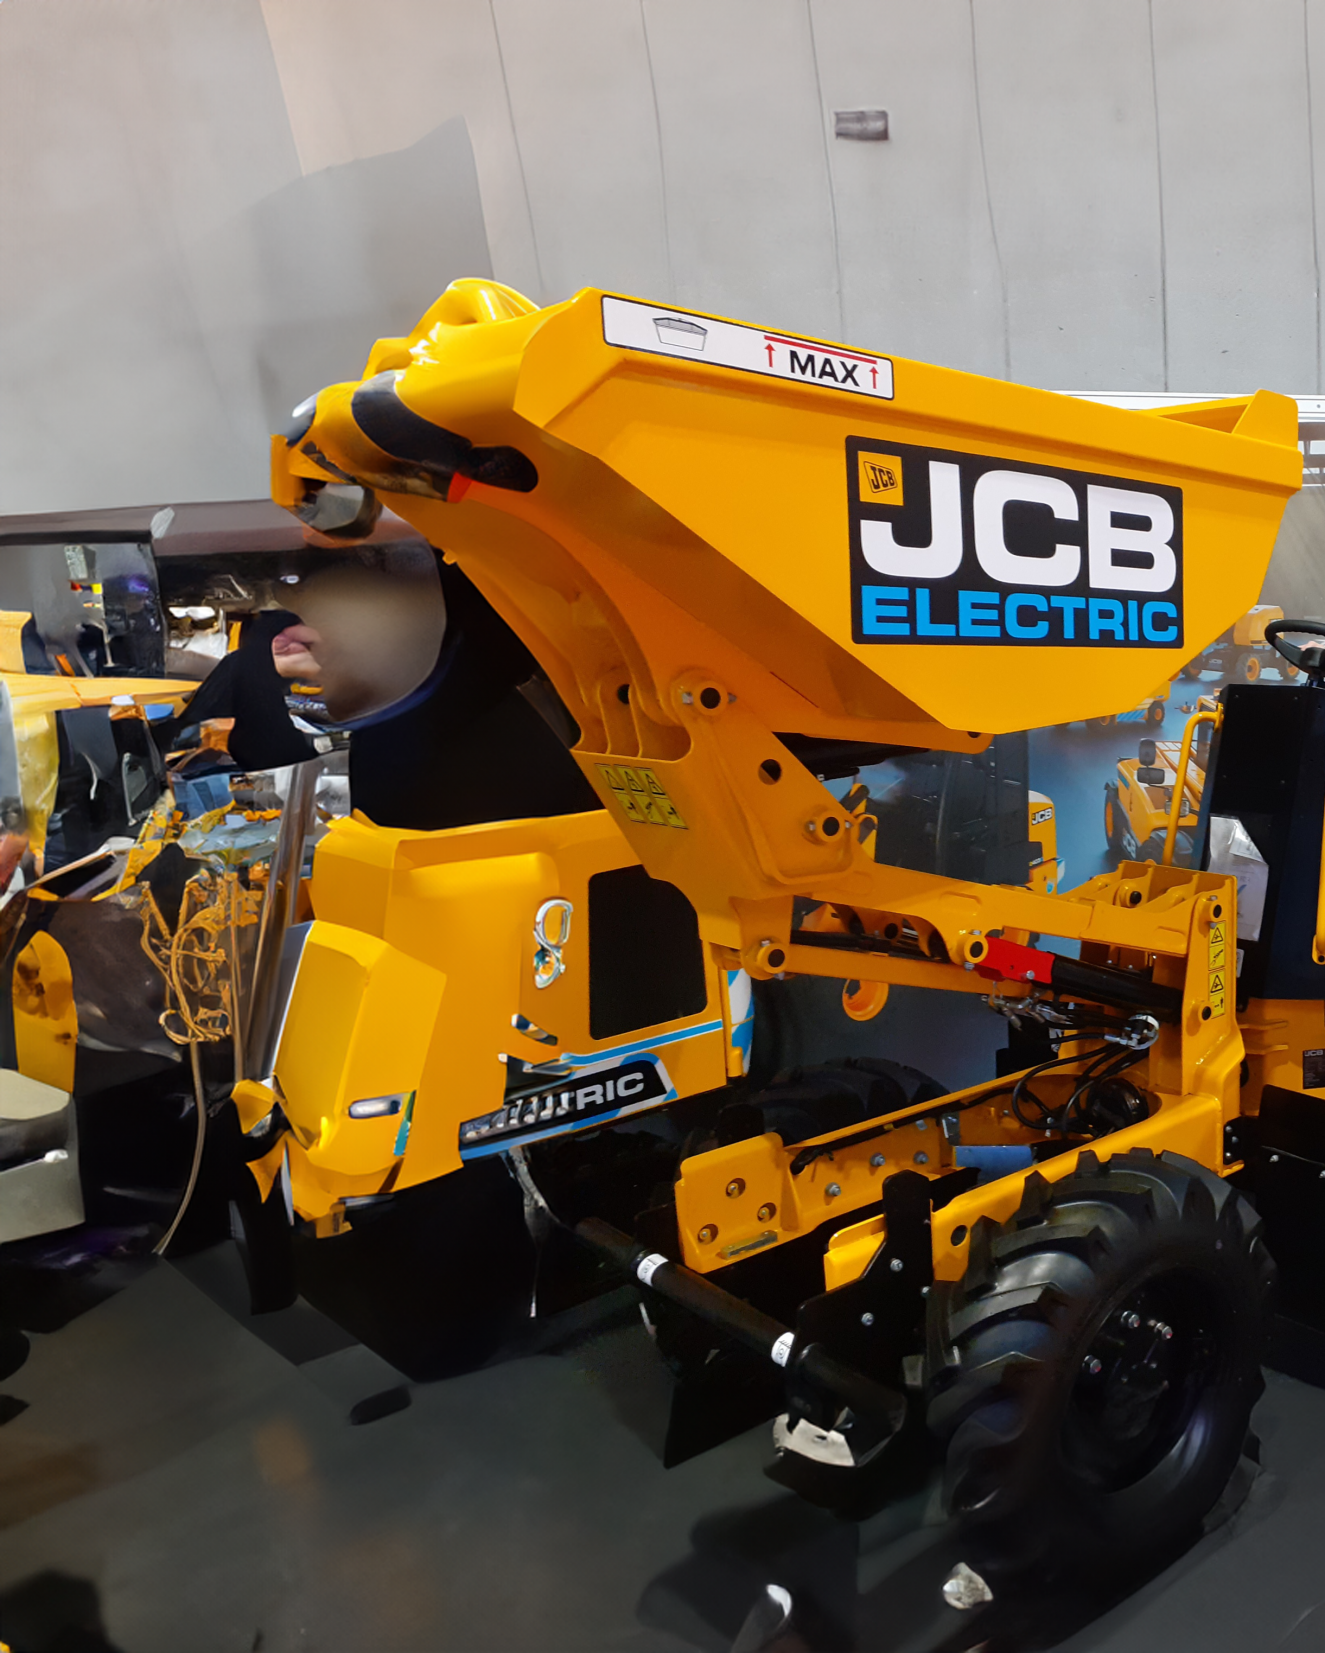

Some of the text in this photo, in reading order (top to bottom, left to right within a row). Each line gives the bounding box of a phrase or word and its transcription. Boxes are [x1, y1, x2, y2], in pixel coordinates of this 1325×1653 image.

[790, 350, 860, 387] MAX
[870, 465, 895, 490] JCB
[860, 460, 1176, 593] JCB
[861, 585, 1178, 642] ELECTRIC
[1032, 807, 1053, 826] JCB
[1304, 1049, 1324, 1057] JCB
